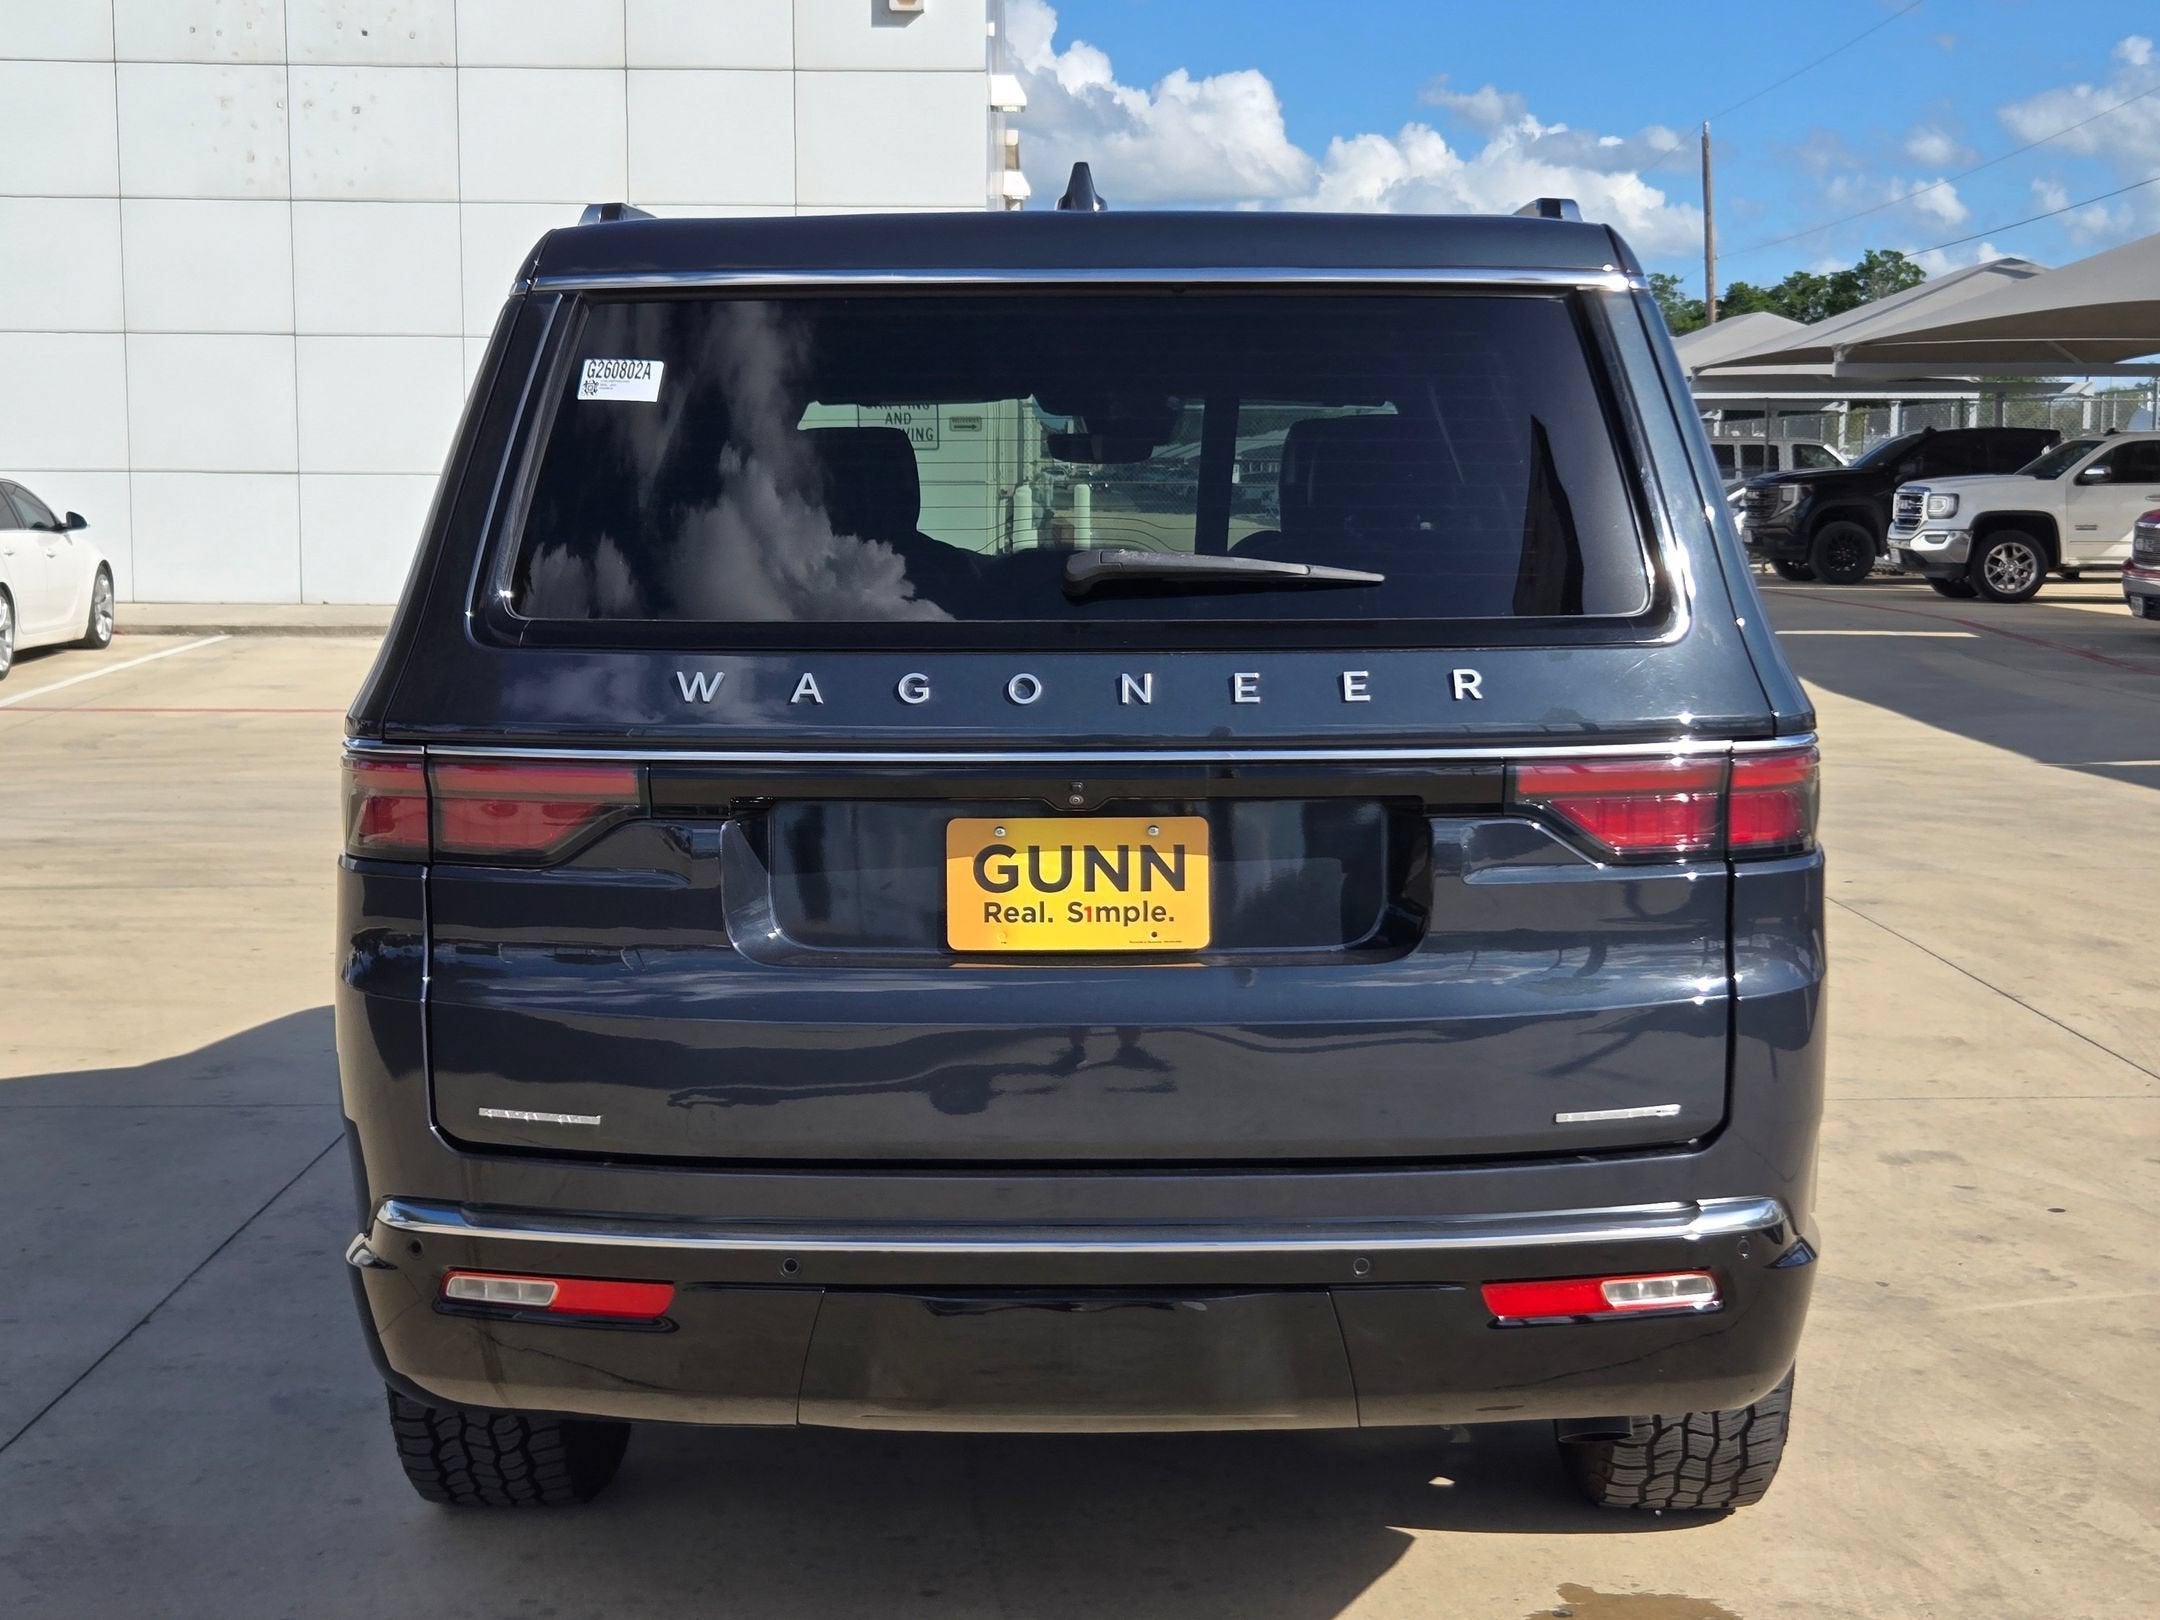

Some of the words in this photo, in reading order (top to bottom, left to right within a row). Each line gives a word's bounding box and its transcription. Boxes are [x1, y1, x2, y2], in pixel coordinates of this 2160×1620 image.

[587, 360, 651, 380] G260802A
[885, 412, 912, 425] AND
[676, 668, 1483, 705] WAGONEER
[972, 844, 1186, 894] GUNN
[983, 902, 1053, 923] Real.
